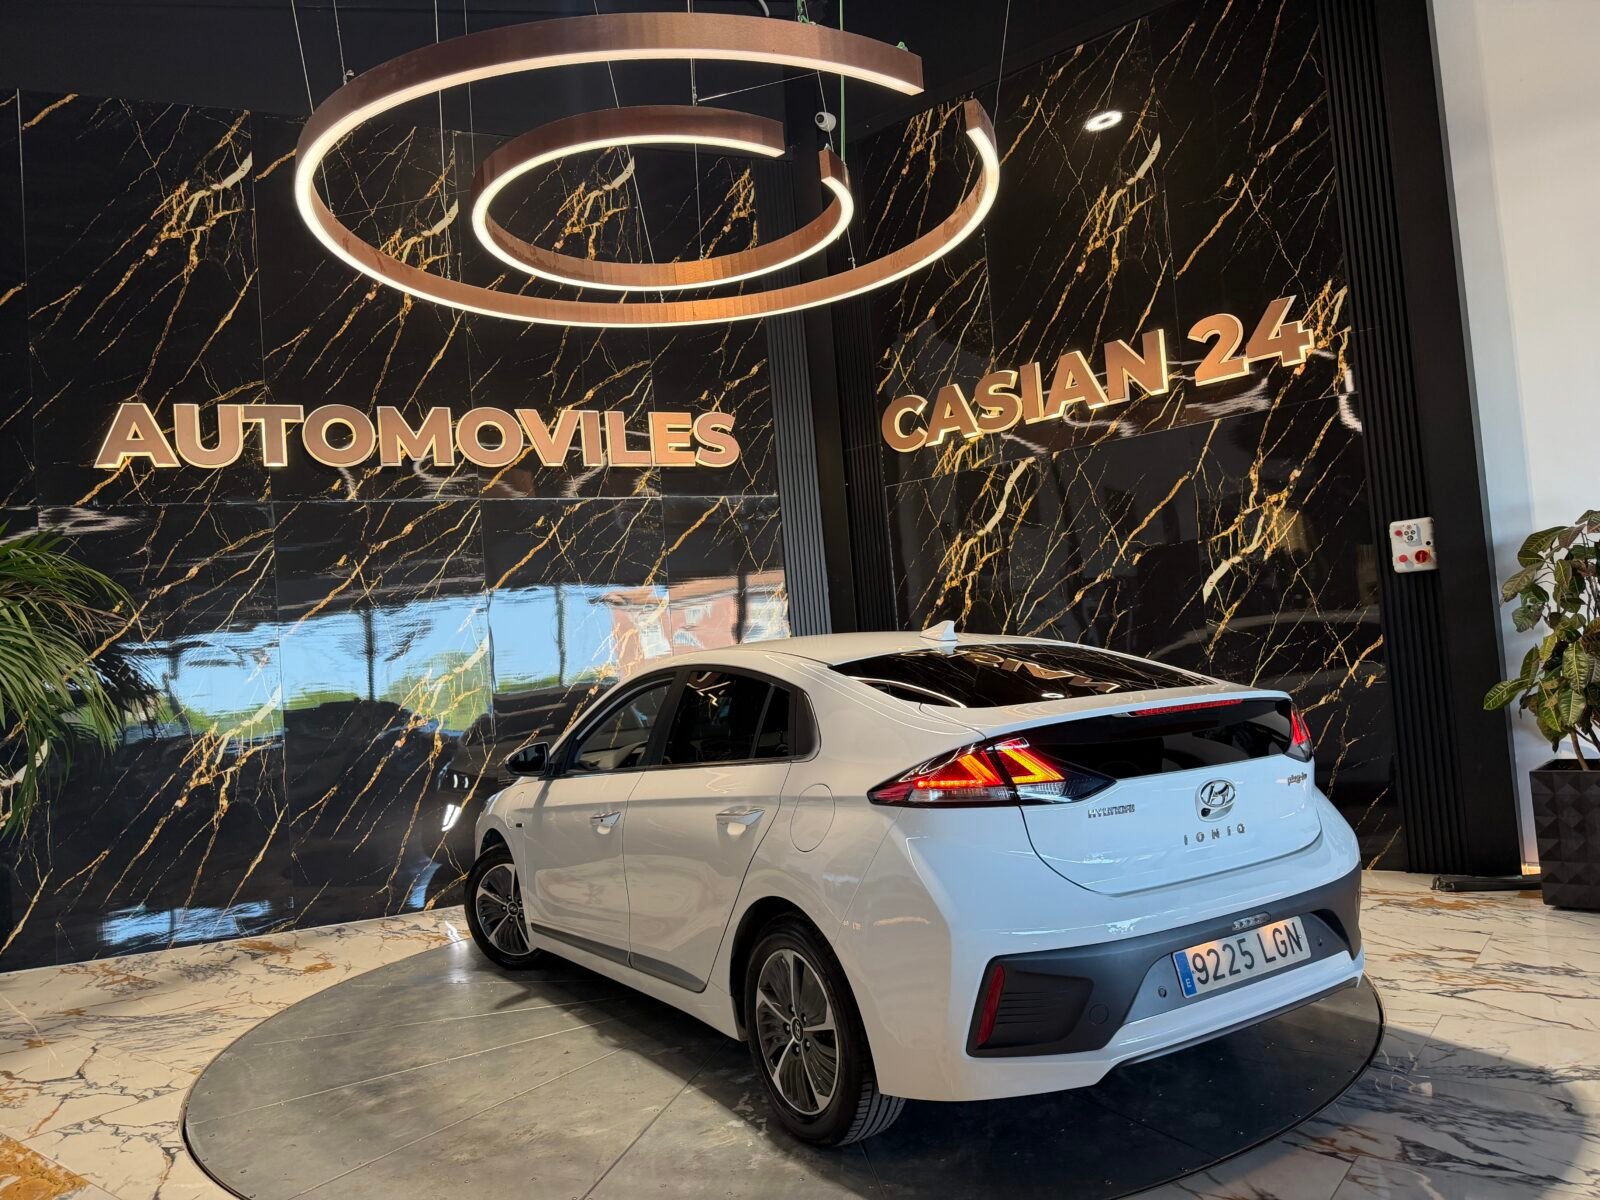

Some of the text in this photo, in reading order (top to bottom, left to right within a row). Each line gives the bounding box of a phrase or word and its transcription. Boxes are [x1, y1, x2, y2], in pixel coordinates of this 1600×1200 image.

[881, 295, 1314, 453] CASIAN 24
[94, 402, 741, 469] AUTOMOVILES
[1191, 938, 1255, 985] 9225
[1257, 922, 1303, 964] LGN
